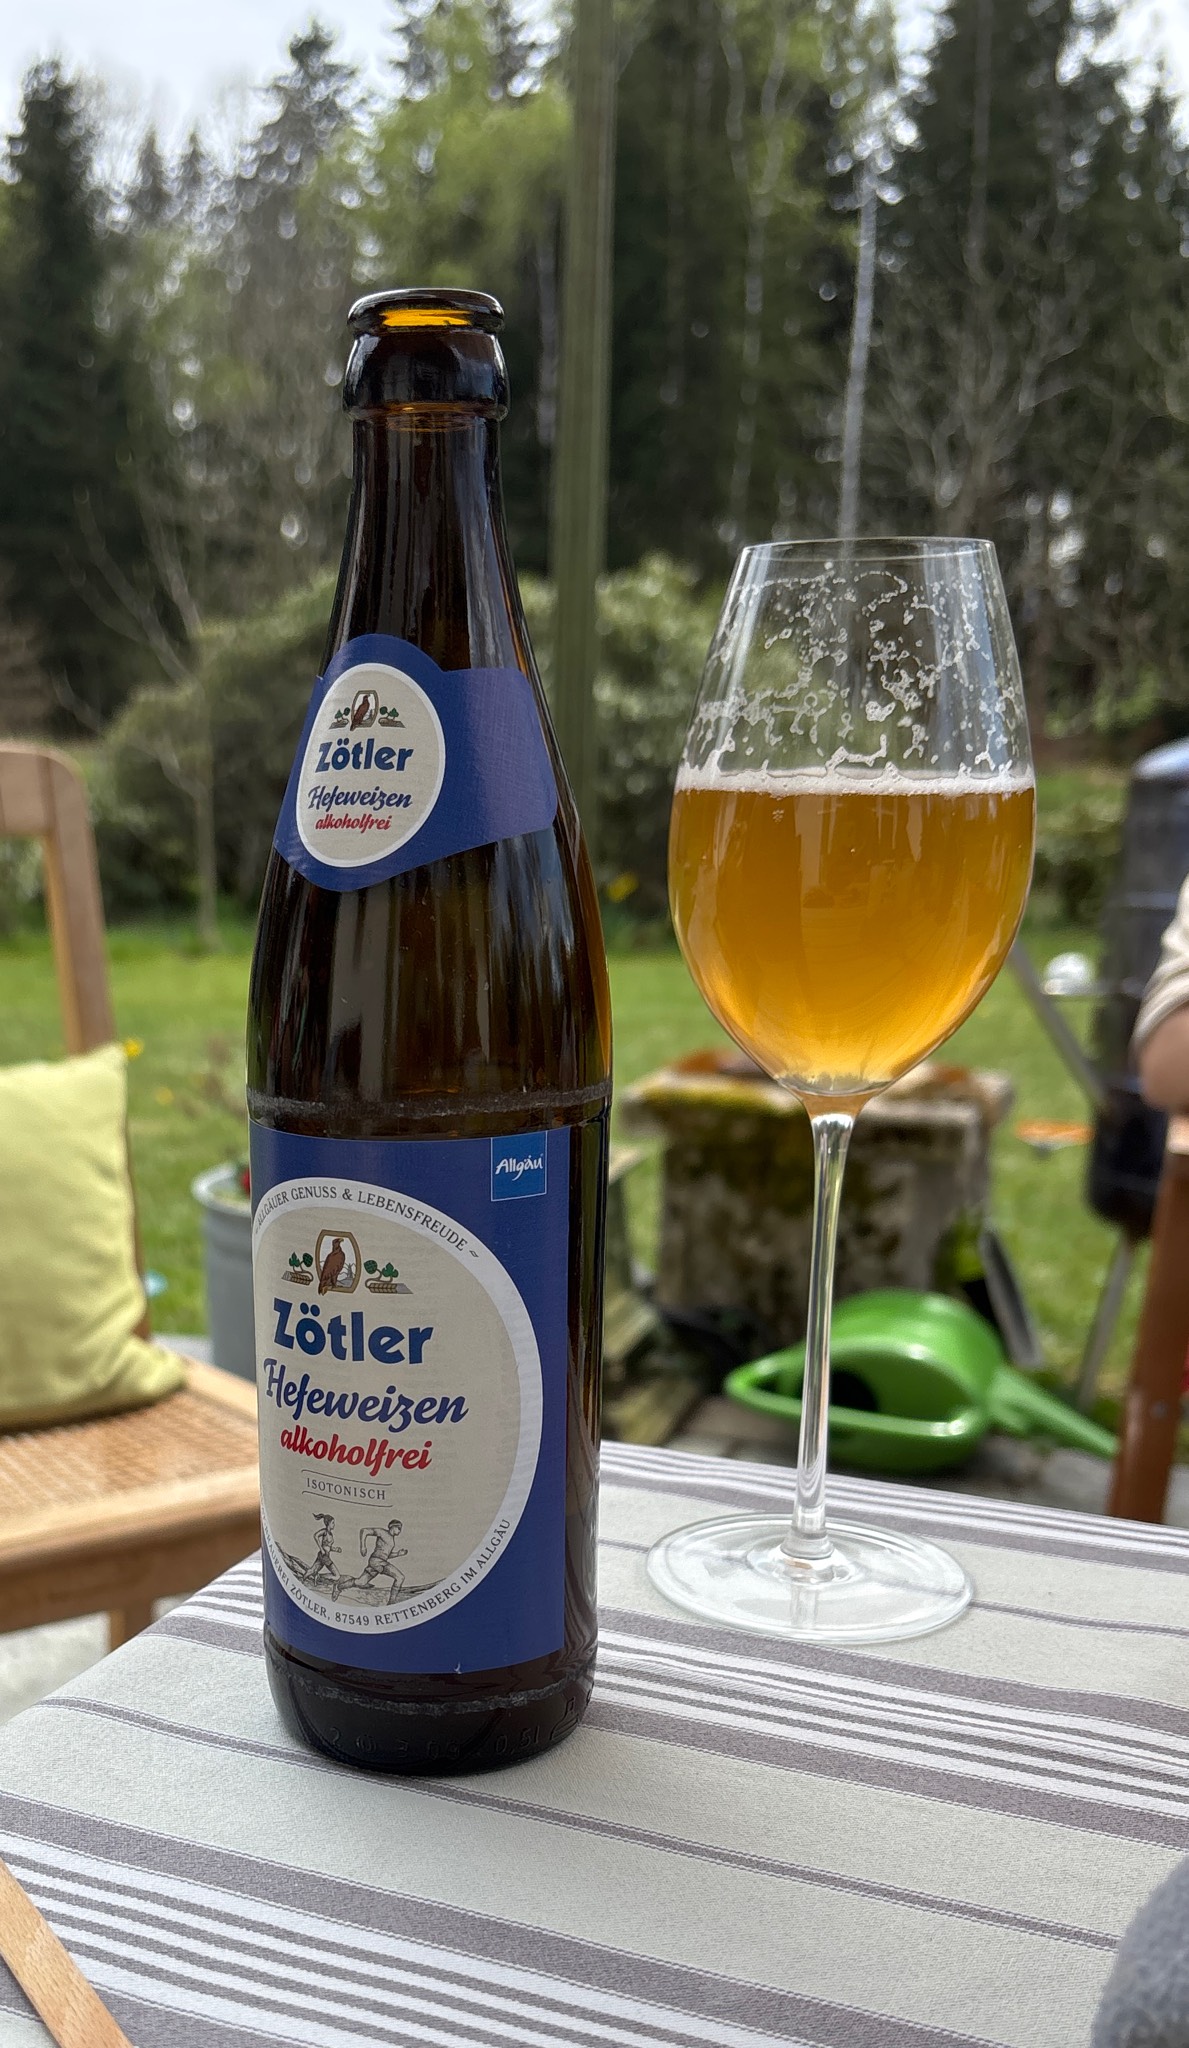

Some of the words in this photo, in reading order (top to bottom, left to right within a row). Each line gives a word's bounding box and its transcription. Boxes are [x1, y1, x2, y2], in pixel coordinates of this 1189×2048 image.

[315, 738, 414, 773] Zötler
[308, 786, 413, 812] Hefeweizen
[315, 814, 392, 833] alkoholfrei
[495, 1154, 544, 1181] Allgäu
[256, 1190, 290, 1226] ALLGÄUER
[291, 1185, 337, 1201] GENUSS
[341, 1188, 354, 1201] &
[358, 1190, 469, 1252] LEBENSFREUDE
[272, 1297, 434, 1365] Zötler
[263, 1357, 469, 1432] Hefeweizen
[280, 1425, 432, 1476] alkoholfrei
[306, 1477, 387, 1501] ISOTONISCH
[290, 1584, 331, 1620] ZÖTLER,
[335, 1611, 370, 1626] 87549
[374, 1582, 462, 1626] RETTENBERG
[460, 1566, 479, 1585] IM
[477, 1518, 511, 1569] ALLGÄU
